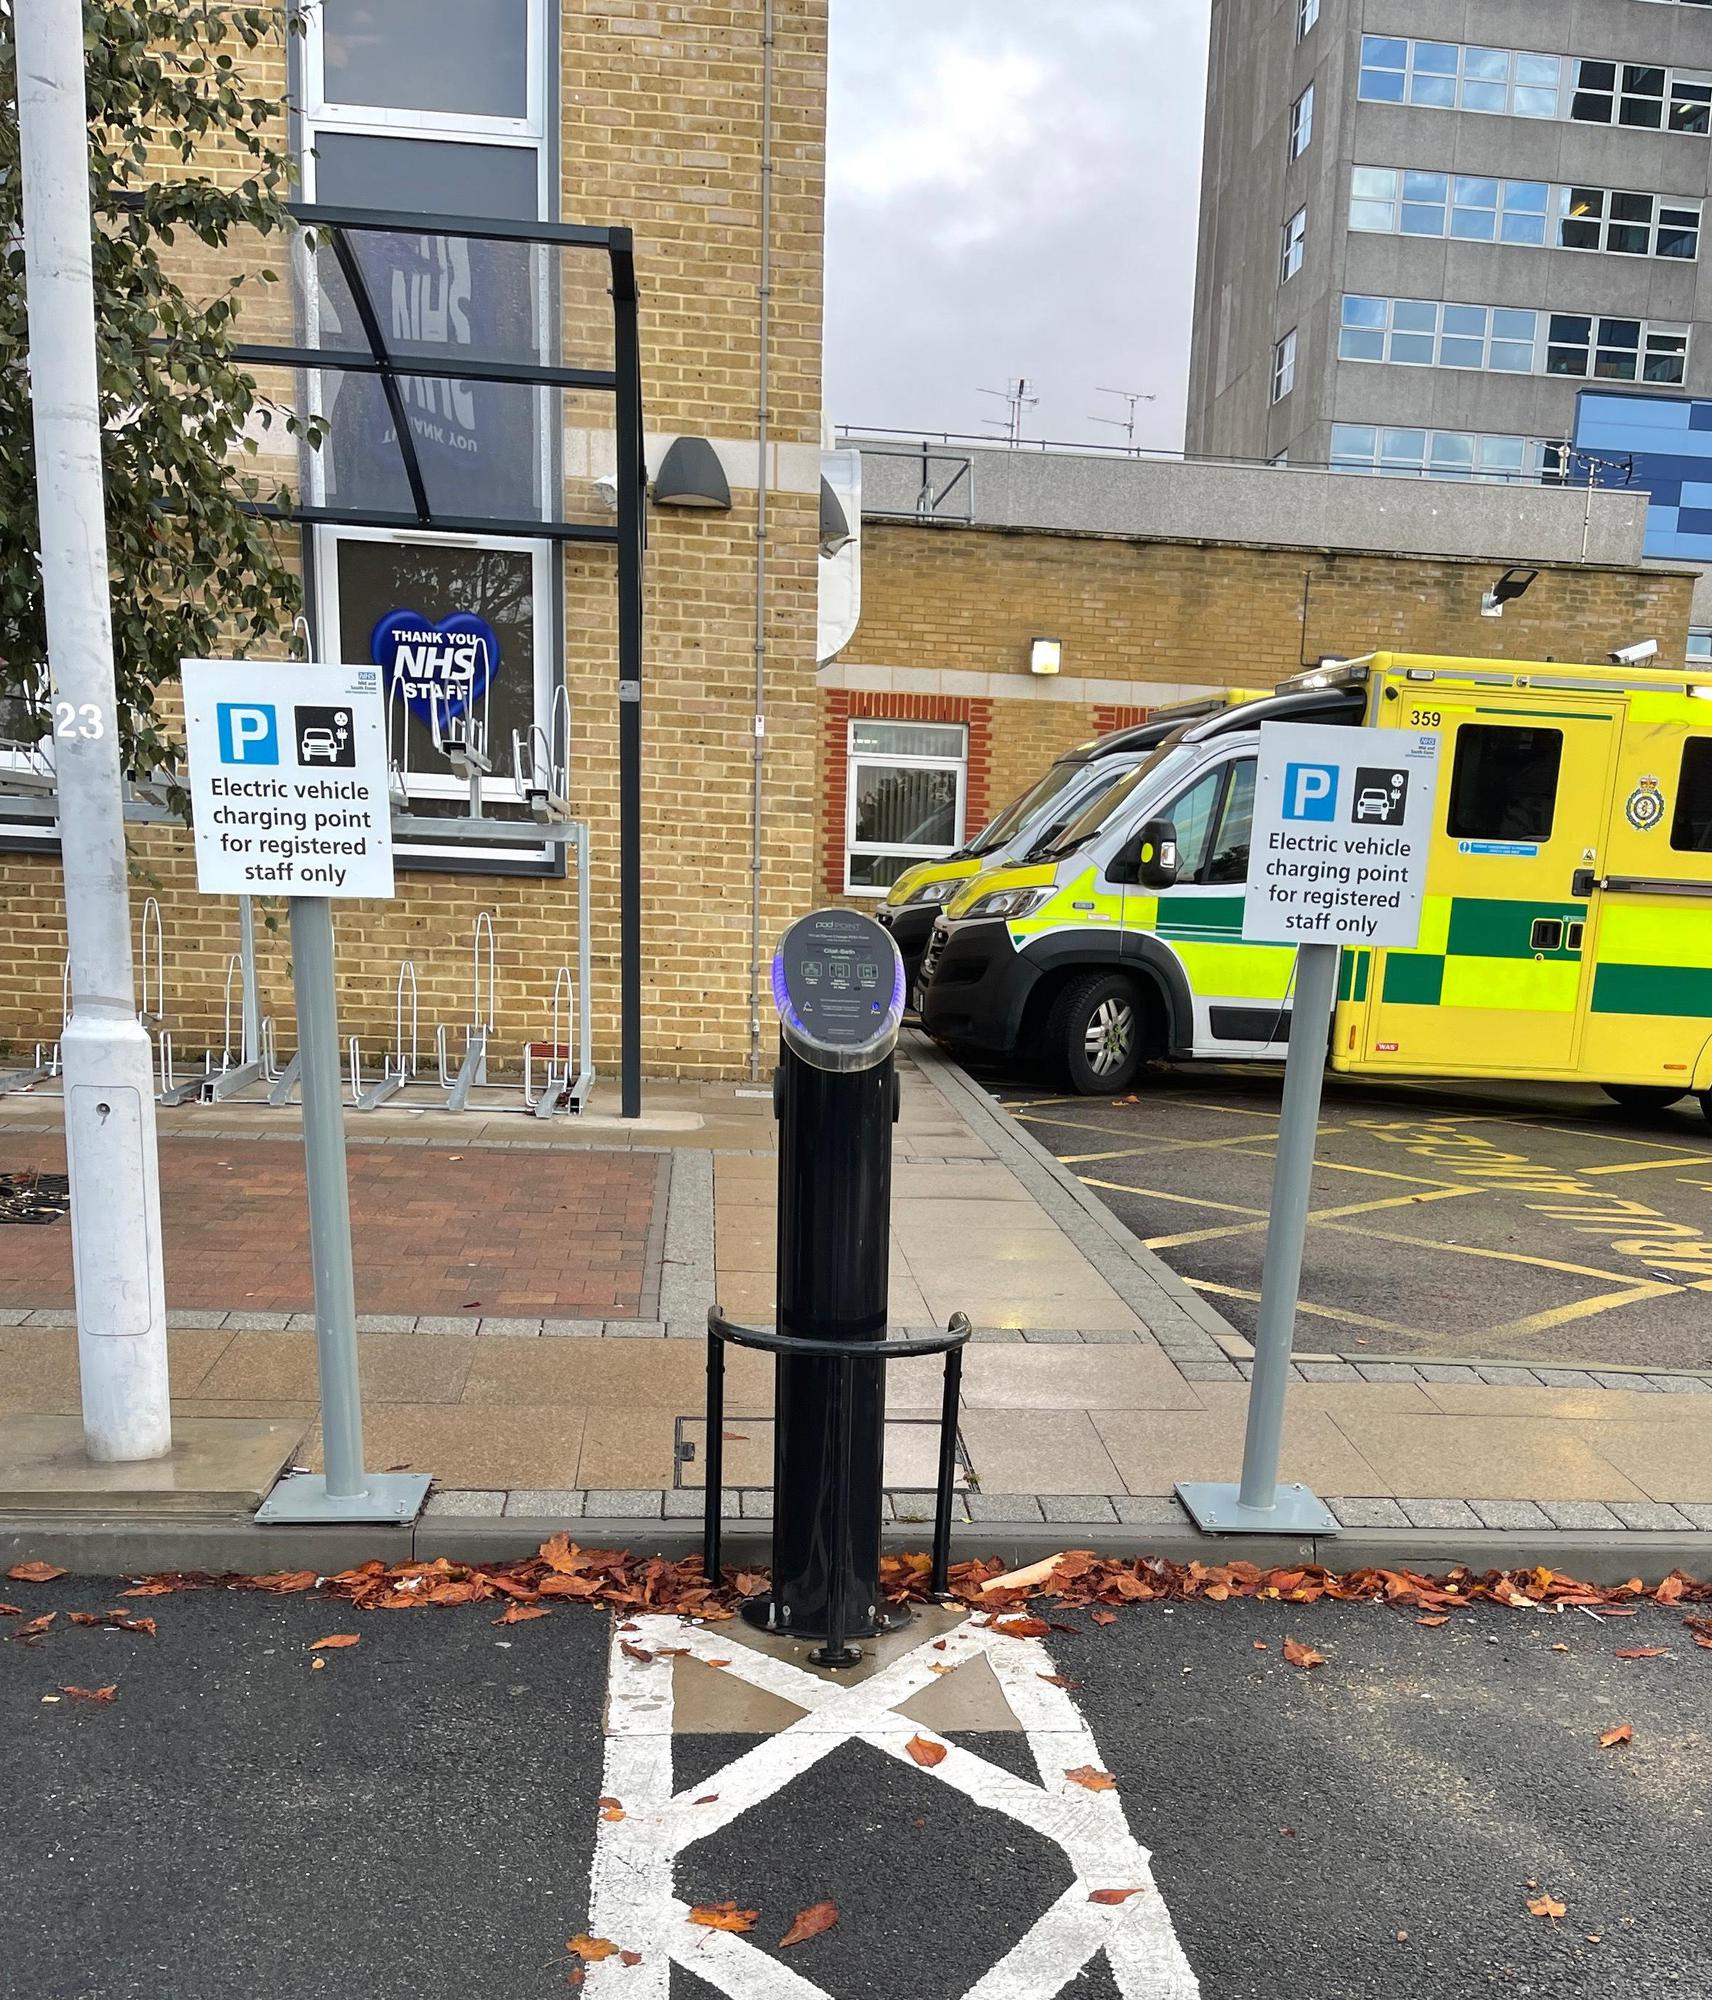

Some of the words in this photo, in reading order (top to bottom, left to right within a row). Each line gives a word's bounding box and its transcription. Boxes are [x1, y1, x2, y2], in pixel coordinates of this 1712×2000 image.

[392, 630, 443, 644] THANK
[446, 632, 477, 645] YOU
[393, 645, 476, 681] NHS
[358, 672, 376, 680] NHS
[405, 682, 469, 700] STAFF
[56, 702, 104, 740] 23
[1410, 710, 1441, 727] 359
[229, 708, 269, 760] P
[211, 777, 288, 798] Electric
[293, 780, 369, 800] vehicle
[1294, 768, 1331, 816] P
[213, 805, 307, 830] charging
[315, 808, 371, 831] point
[220, 833, 252, 853] for
[259, 836, 367, 858] registered
[1269, 832, 1338, 853] Electric
[1344, 837, 1411, 857] vehicle
[245, 862, 293, 881] staff
[300, 863, 347, 887] only
[1266, 859, 1350, 884] charging
[1357, 864, 1409, 884] point
[1269, 884, 1298, 903] for
[1303, 887, 1401, 909] registered
[816, 920, 833, 929] pod
[1286, 912, 1331, 930] staff
[1336, 915, 1378, 937] only
